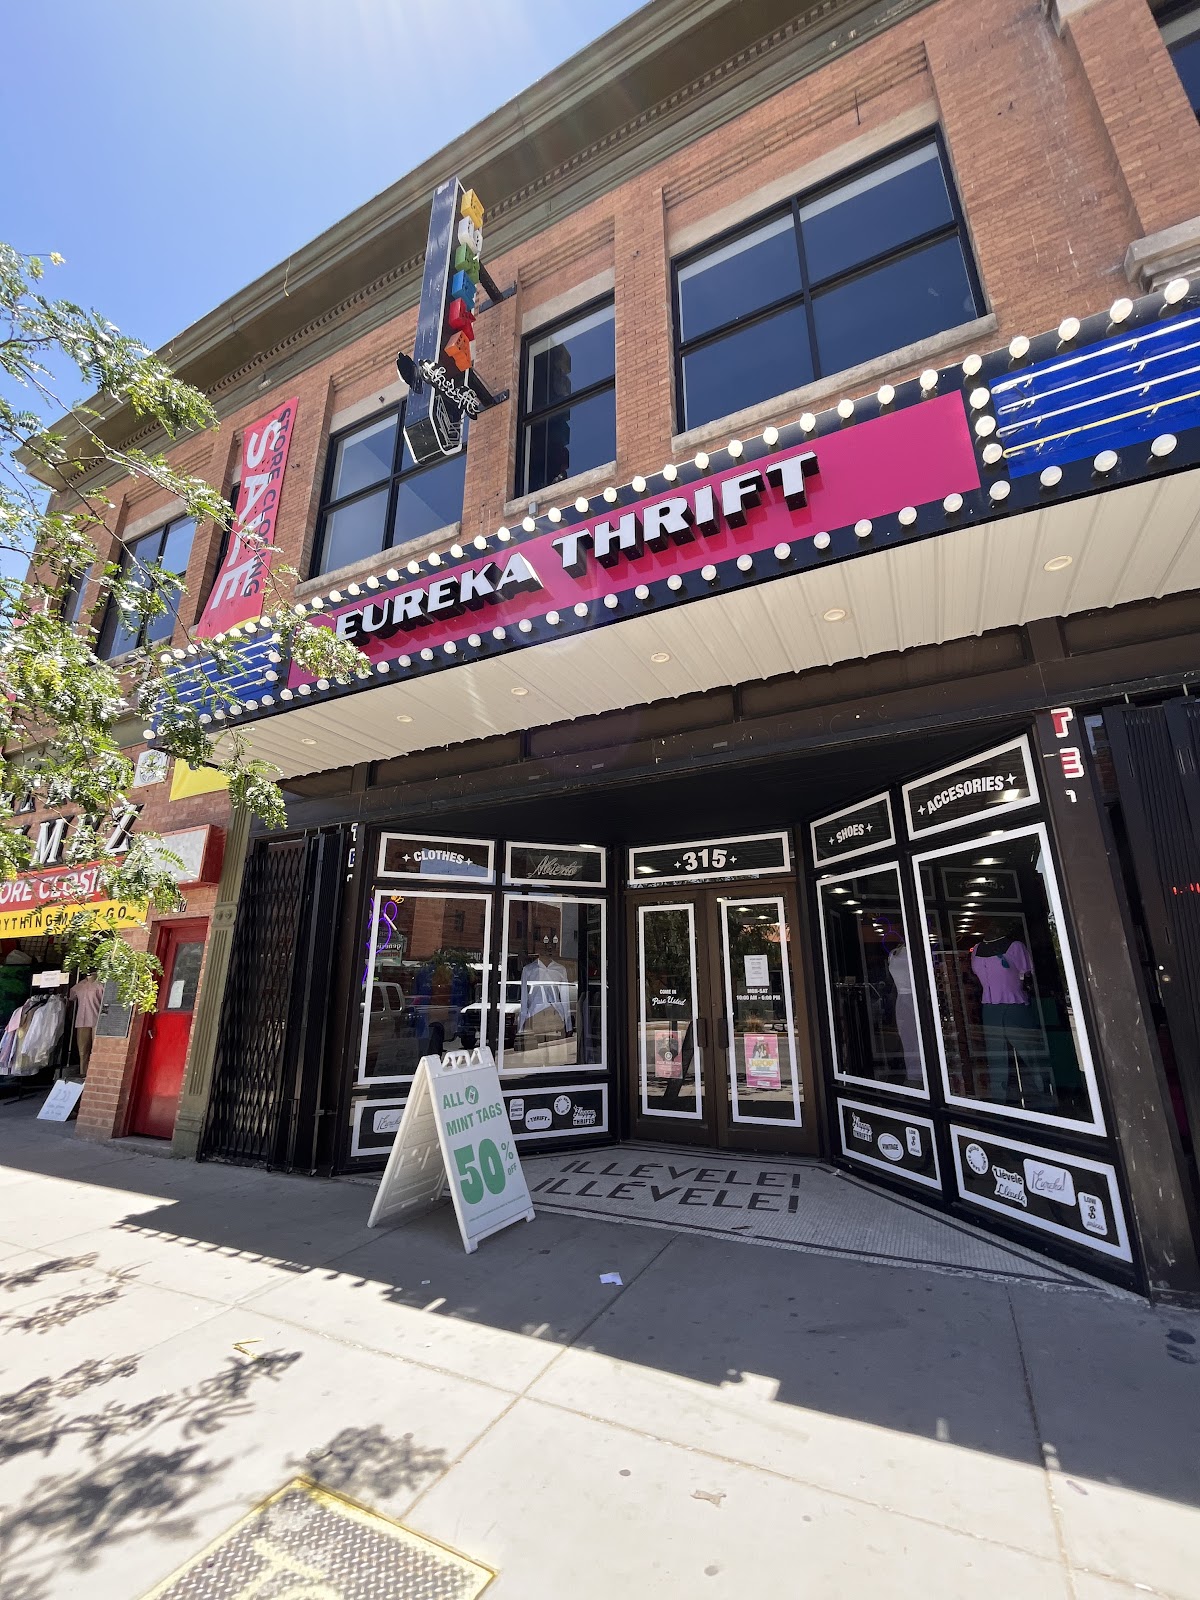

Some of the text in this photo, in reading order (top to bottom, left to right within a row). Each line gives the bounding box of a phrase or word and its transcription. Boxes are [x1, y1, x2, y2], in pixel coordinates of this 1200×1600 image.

[268, 407, 291, 484] STORE
[210, 419, 282, 610] SALE
[335, 450, 819, 641] EUREKA THRIFT
[926, 774, 1005, 815] ACCESORIES
[836, 823, 865, 843] SHOES
[413, 850, 465, 865] CLOTHES
[682, 849, 728, 871] 315
[443, 1092, 464, 1109] ALL
[446, 1102, 503, 1137] MINT TAGS
[882, 1143, 899, 1151] VINTAGE
[507, 1162, 517, 1176] OFF
[1083, 1195, 1097, 1205] LOW
